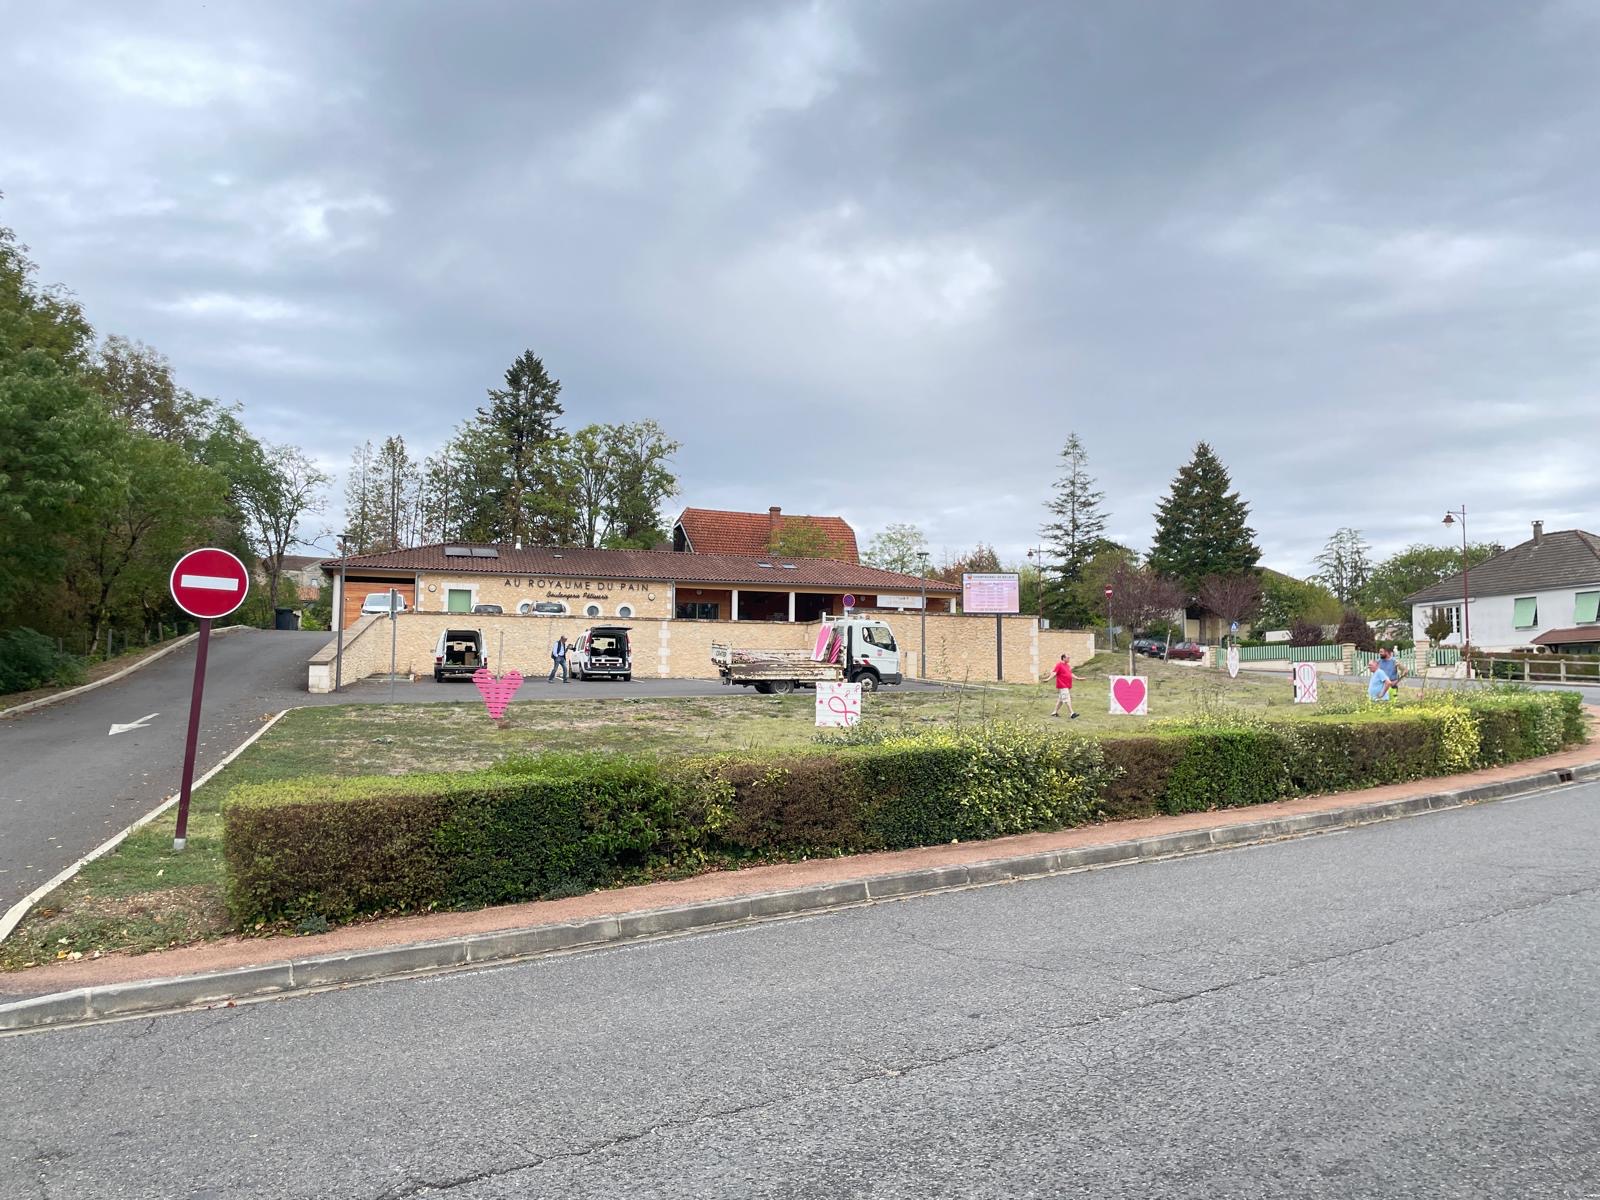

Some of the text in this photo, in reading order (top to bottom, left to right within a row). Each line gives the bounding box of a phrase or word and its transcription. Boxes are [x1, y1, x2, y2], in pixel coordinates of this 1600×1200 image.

[504, 578, 649, 592] AU ROYAUME DU PAIN
